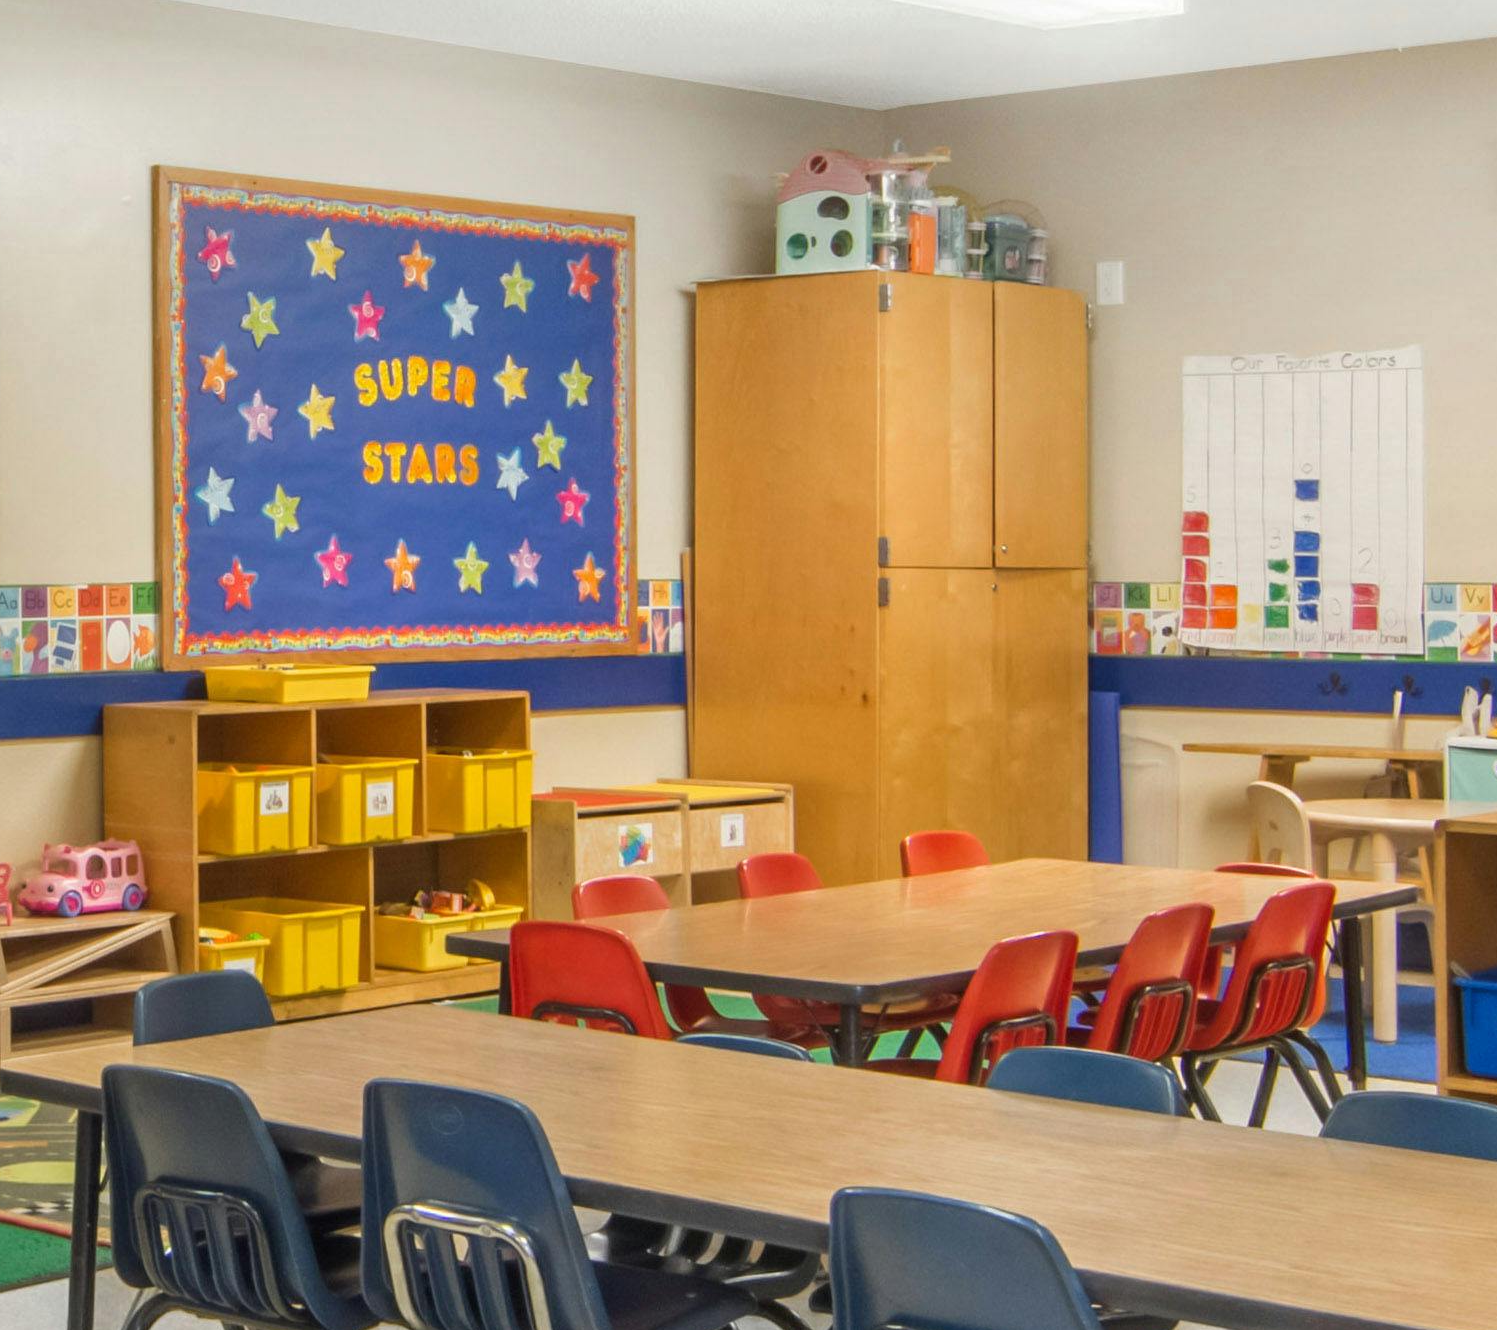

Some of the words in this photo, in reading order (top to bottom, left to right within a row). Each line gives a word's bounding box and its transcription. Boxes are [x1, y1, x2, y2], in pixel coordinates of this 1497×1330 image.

[1230, 355, 1264, 372] Our
[1276, 354, 1332, 371] Favorite
[1341, 352, 1397, 370] Colors
[353, 355, 476, 408] SUPER
[362, 440, 480, 486] STARS
[24, 590, 46, 610] Bb
[53, 590, 73, 609] Cc
[79, 589, 99, 608] Dd
[109, 588, 128, 608] Ee
[1430, 587, 1453, 605] Uu
[1464, 587, 1485, 605] Vv
